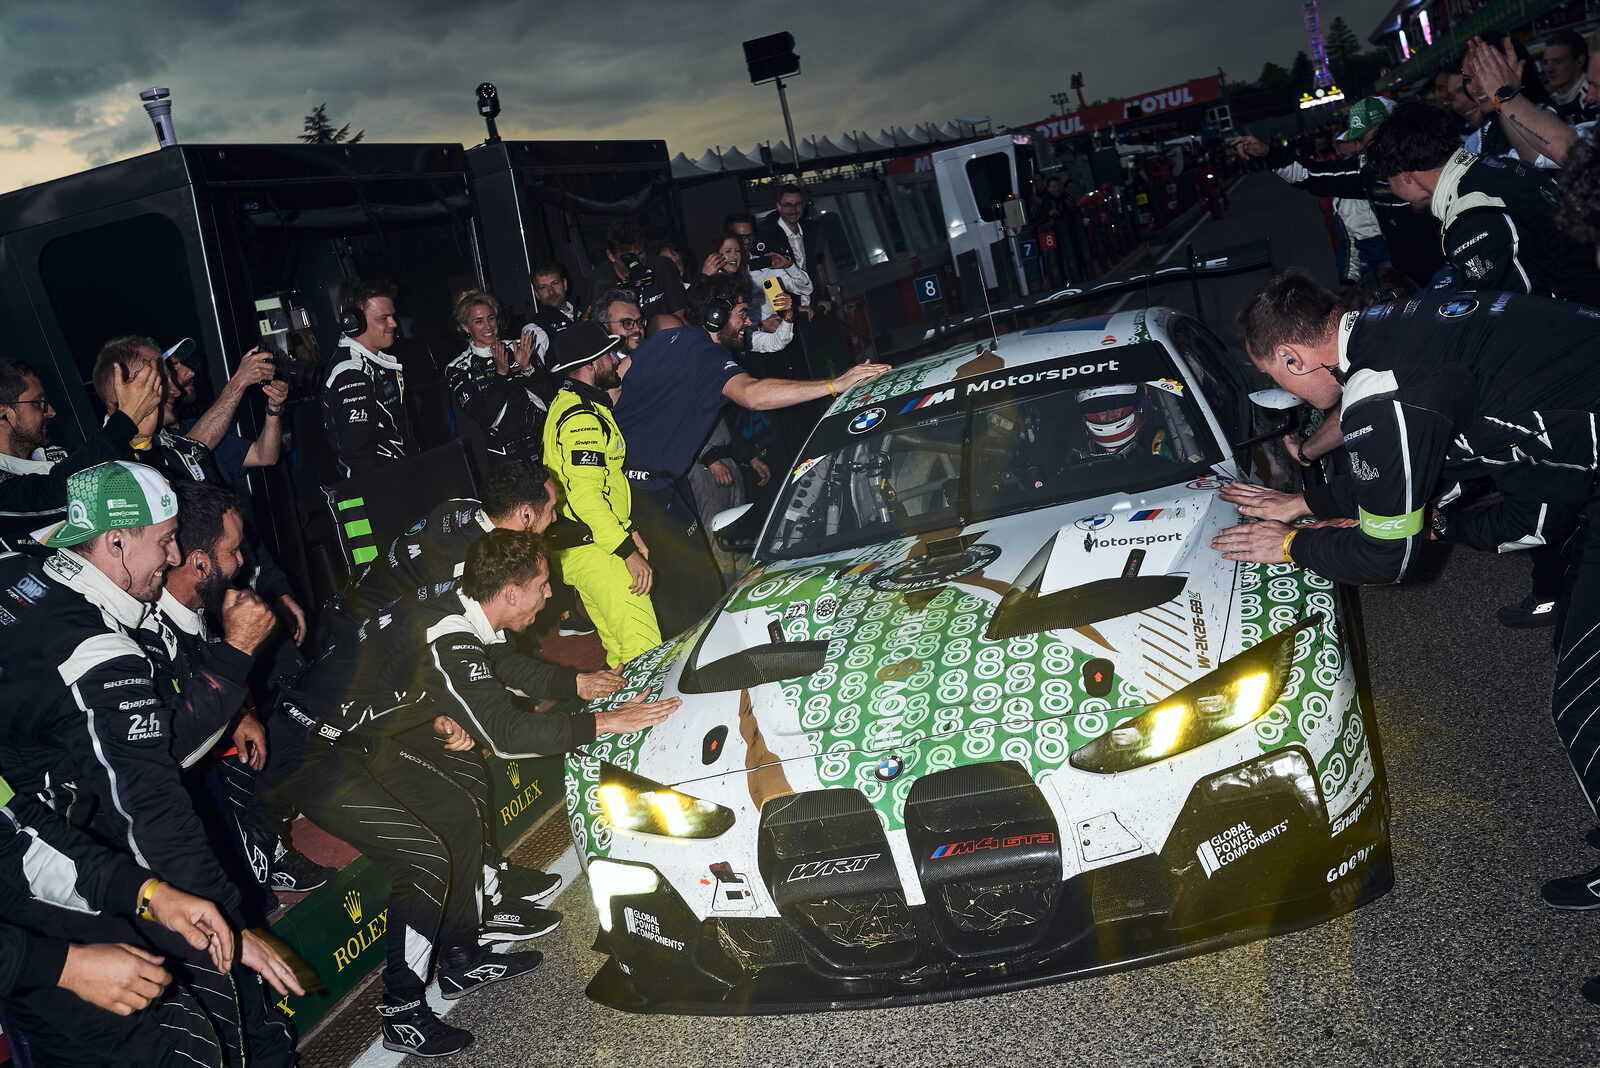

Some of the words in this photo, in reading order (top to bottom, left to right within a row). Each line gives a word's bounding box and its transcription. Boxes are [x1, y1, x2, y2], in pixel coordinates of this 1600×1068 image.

[1123, 87, 1193, 120] MOTUL
[1035, 116, 1085, 138] OTUL
[1046, 235, 1053, 247] 8
[1023, 244, 1032, 257] 7
[924, 280, 936, 297] 8
[921, 388, 956, 408] M
[966, 359, 1120, 396] Motorsport
[581, 451, 599, 462] 24h
[1365, 518, 1407, 530] WEC
[1086, 532, 1182, 548] Motorsport
[468, 661, 490, 678] 24h
[128, 712, 161, 735] 24h
[289, 706, 317, 727] WRT
[320, 726, 341, 739] OMP
[500, 779, 543, 827] ROLEX
[1002, 832, 1055, 849] GT3
[1211, 820, 1251, 847] GLOBAL
[1219, 819, 1288, 866] COMPONENTS
[1214, 829, 1255, 857] POWER
[787, 853, 881, 883] WRT
[493, 913, 520, 922] sparco
[633, 909, 660, 926] GLOBAL
[634, 917, 660, 935] POWER
[636, 927, 685, 951] COMPONENTS
